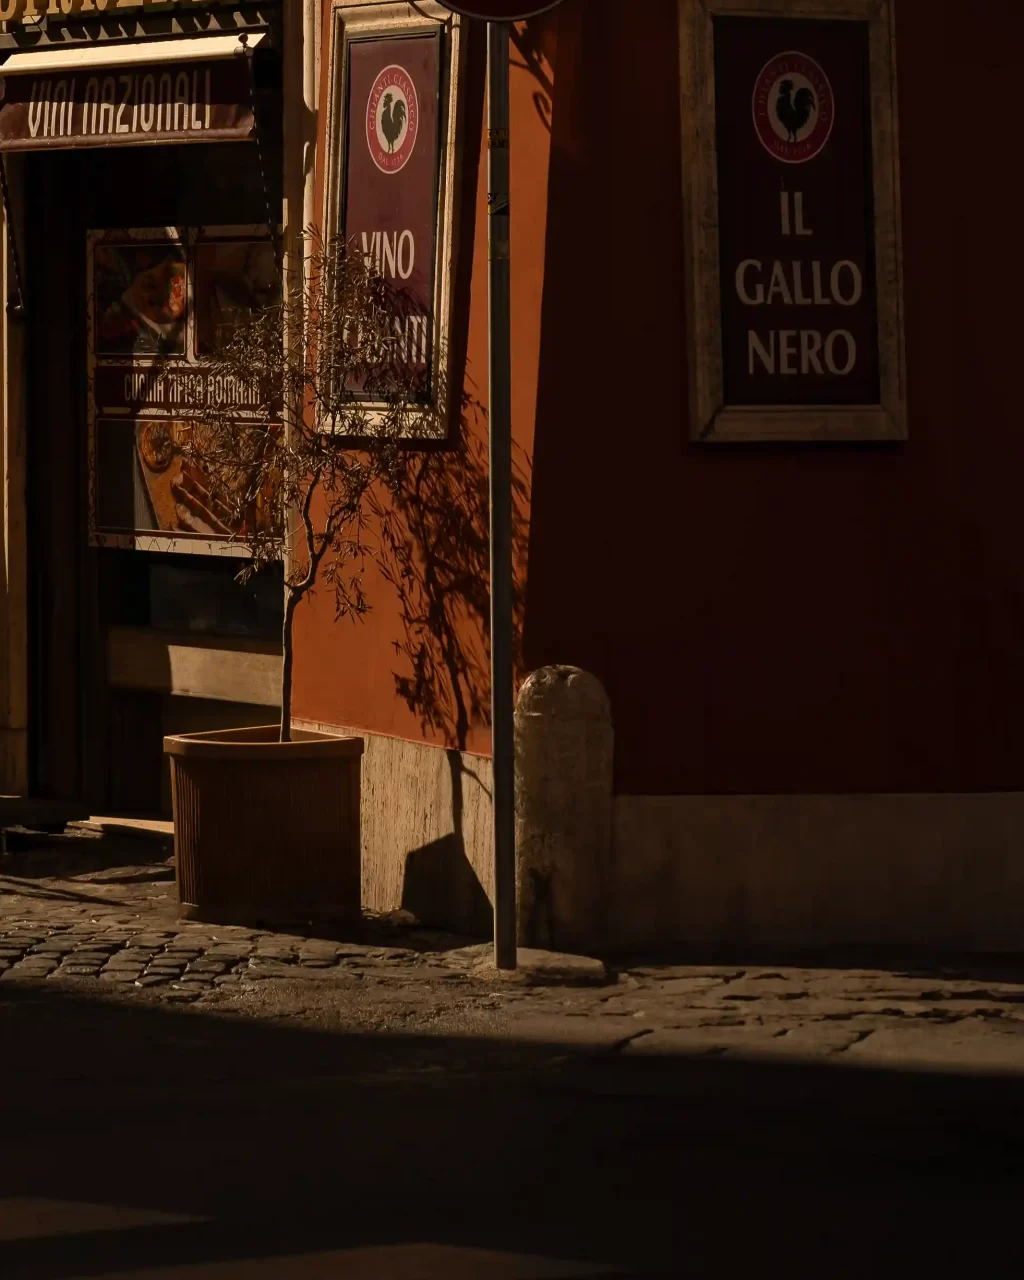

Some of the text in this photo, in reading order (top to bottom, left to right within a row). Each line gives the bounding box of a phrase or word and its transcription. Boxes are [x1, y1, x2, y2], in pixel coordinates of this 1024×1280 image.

[28, 68, 212, 138] VINI NAZIONALI
[780, 190, 814, 236] IL
[361, 229, 415, 280] VINO
[734, 258, 863, 307] GALLO
[747, 328, 857, 376] NERO
[124, 373, 165, 403] CUCINA
